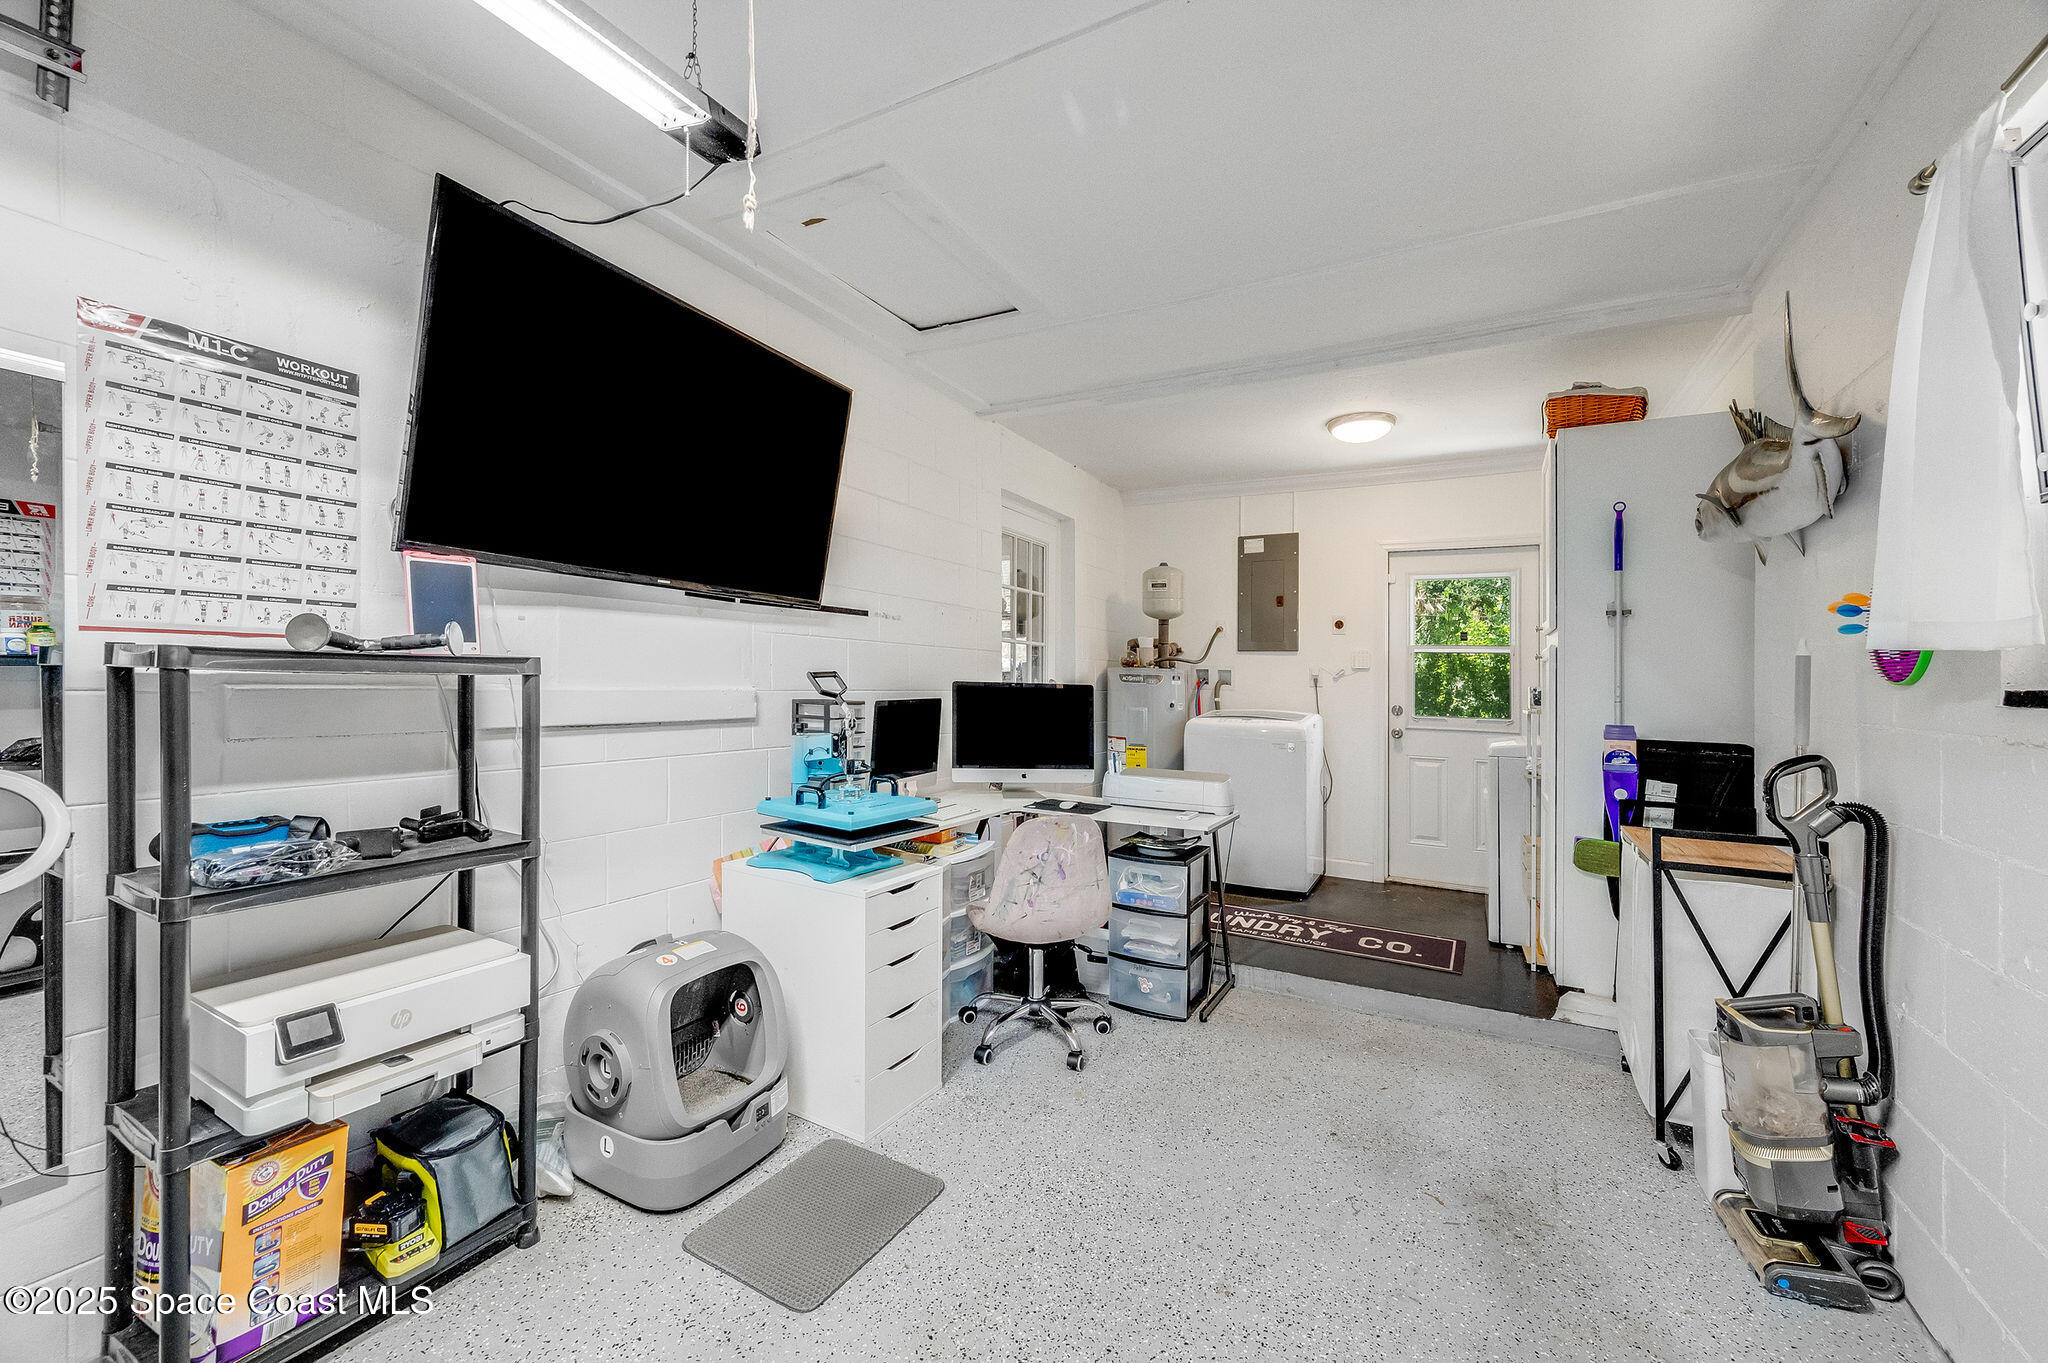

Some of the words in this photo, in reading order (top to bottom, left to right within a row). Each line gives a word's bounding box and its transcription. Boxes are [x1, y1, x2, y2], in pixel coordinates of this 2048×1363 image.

[276, 357, 350, 385] WORKOUT
[1277, 915, 1303, 925] Dry
[1210, 912, 1333, 940] UNDRY
[1357, 936, 1423, 958] CO.
[1231, 927, 1259, 936] SAME
[1285, 936, 1328, 947] SERVICE
[391, 1009, 412, 1030] hp
[603, 1059, 612, 1075] L
[604, 1138, 611, 1154] L
[247, 1177, 295, 1215] DOUBLE
[296, 1155, 328, 1182] DUTY
[252, 1212, 294, 1234] INSTRUCTIONS
[191, 1235, 214, 1256] UTY
[400, 1233, 424, 1250] RYOBI
